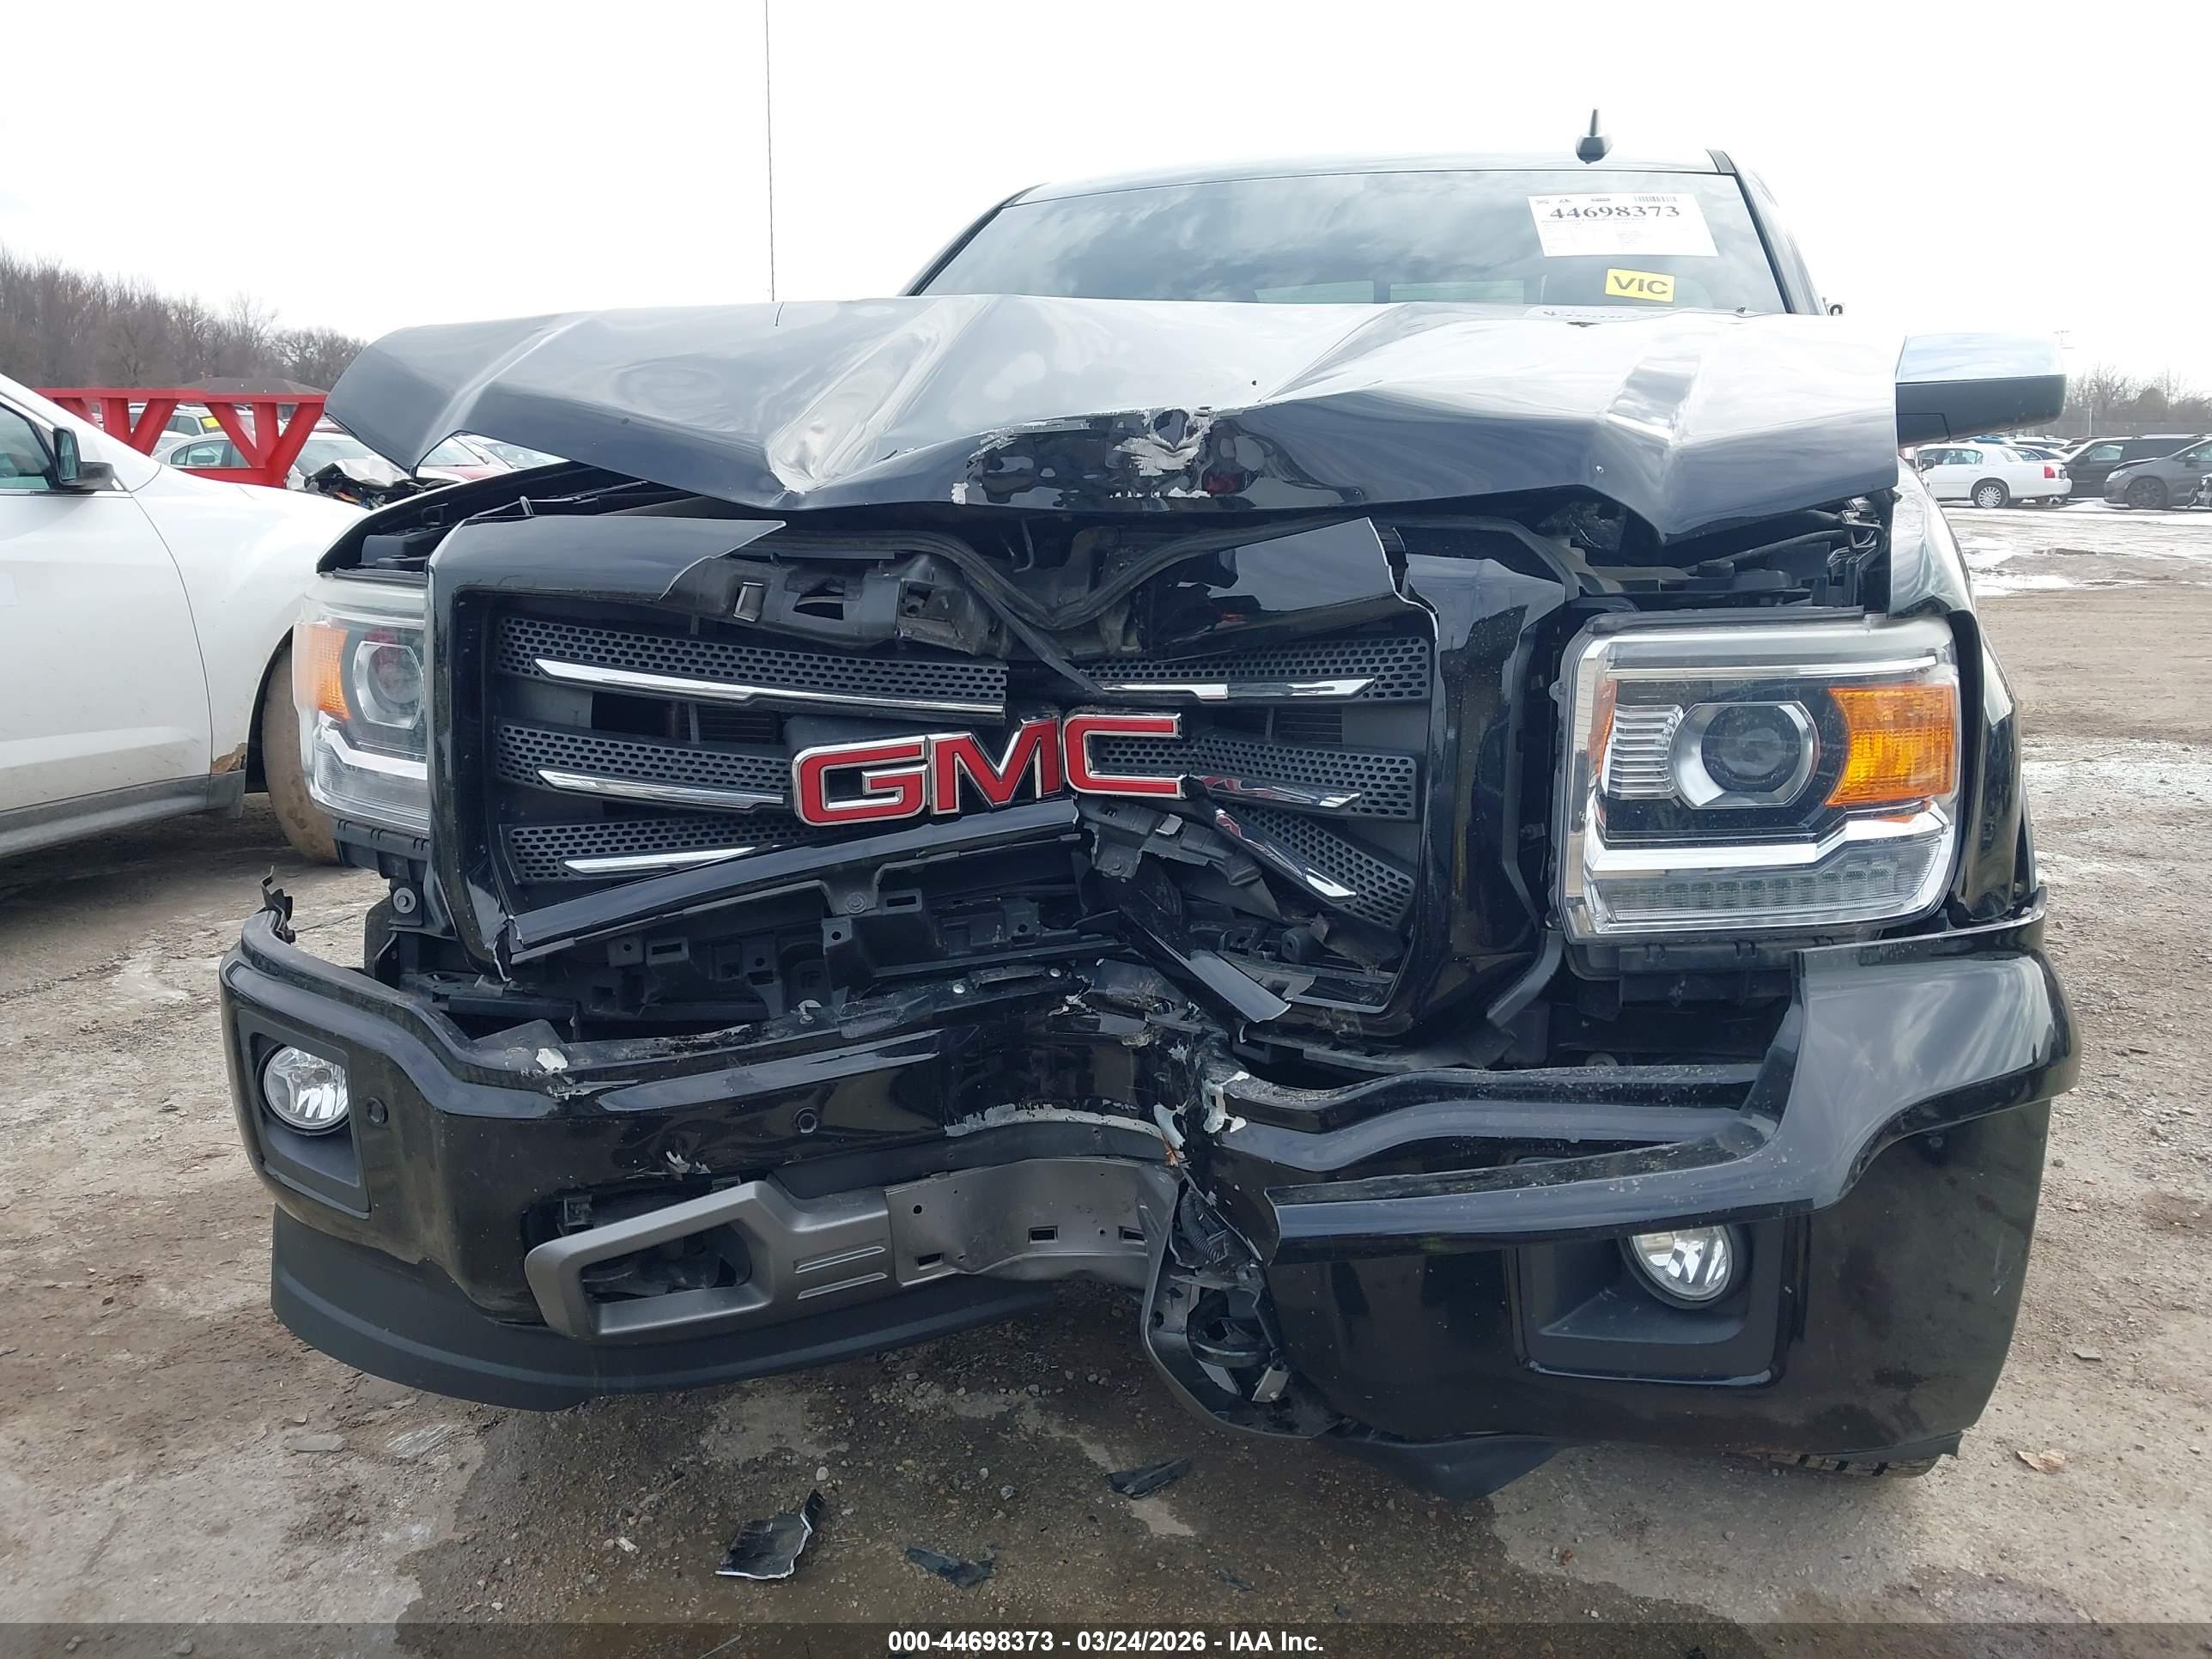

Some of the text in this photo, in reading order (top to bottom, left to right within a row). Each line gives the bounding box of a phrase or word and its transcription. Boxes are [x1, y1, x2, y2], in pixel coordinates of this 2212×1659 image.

[1549, 205, 1680, 219] 44698373
[1613, 276, 1668, 295] VIC
[792, 712, 1188, 826] GMC
